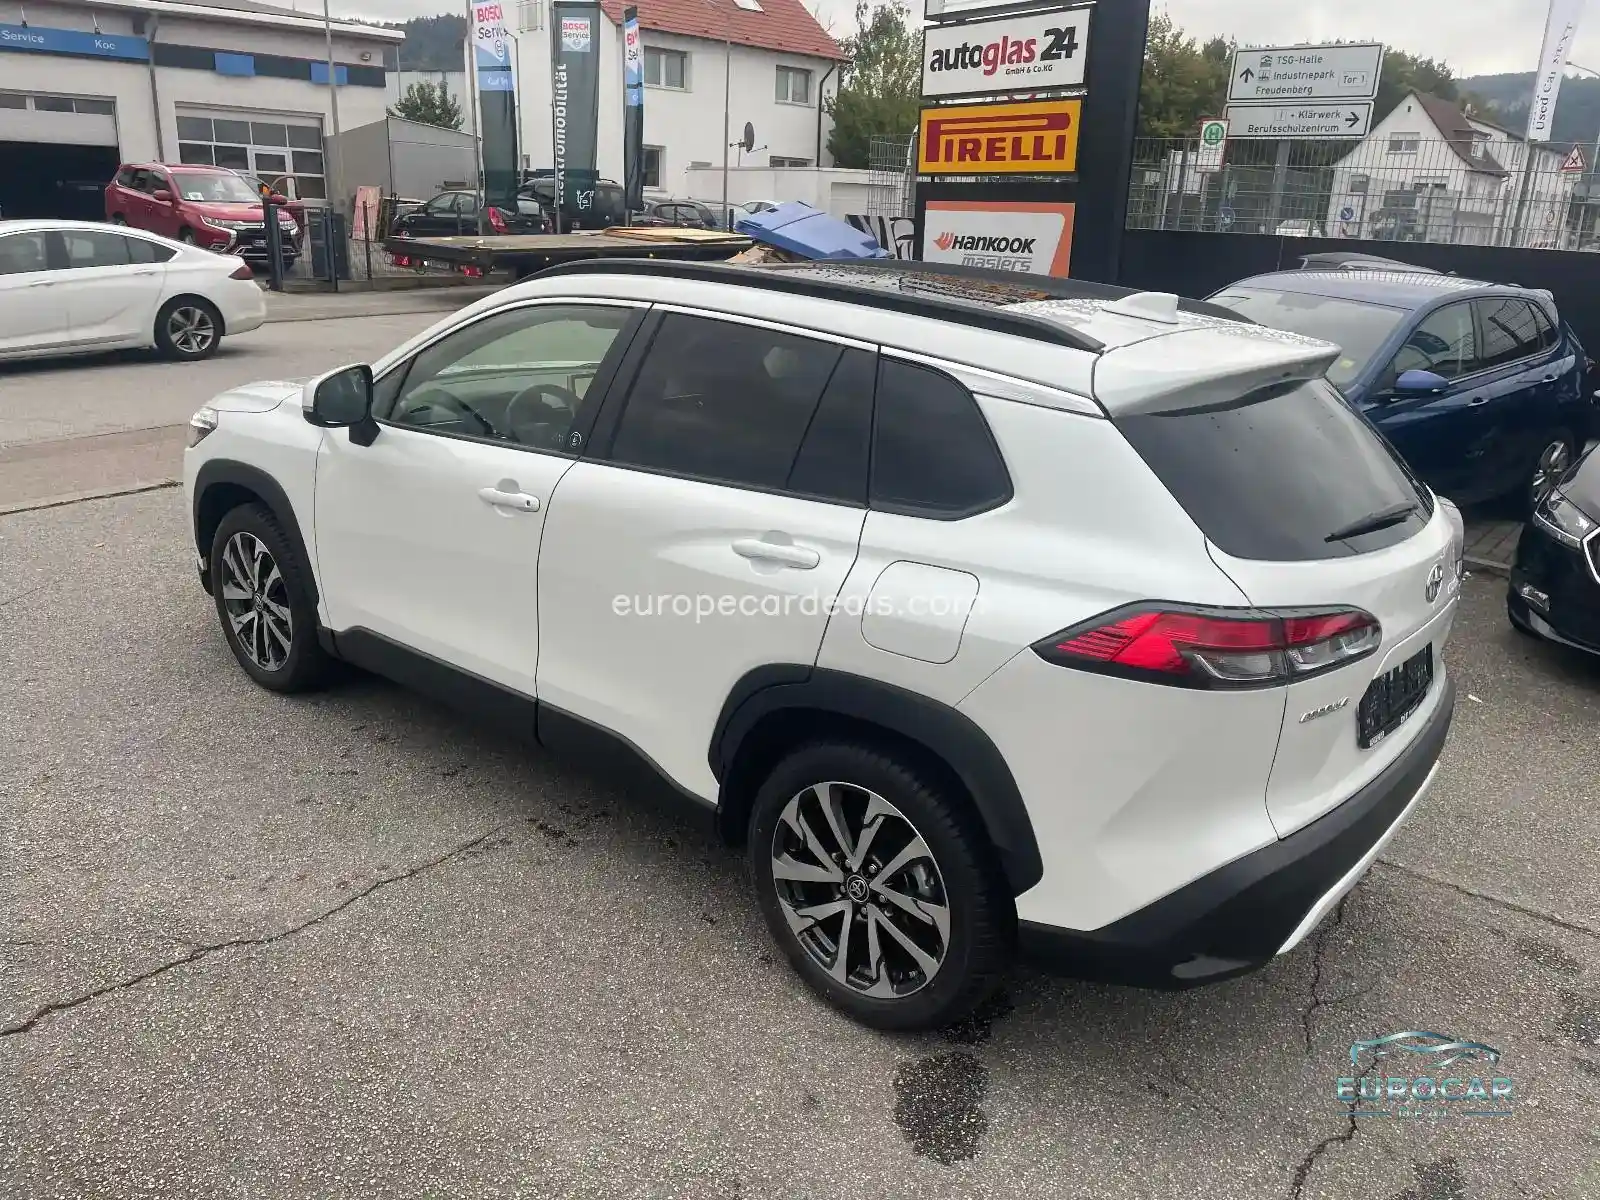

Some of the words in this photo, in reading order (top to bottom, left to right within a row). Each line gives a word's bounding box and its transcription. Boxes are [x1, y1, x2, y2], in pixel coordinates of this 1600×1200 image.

[563, 22, 589, 30] BOSCH
[562, 31, 590, 39] Service
[1, 30, 44, 44] Service
[94, 39, 116, 50] Koc
[930, 36, 1036, 76] autoglas
[1040, 26, 1078, 61] 24
[1276, 55, 1323, 64] TSG-Halle
[1005, 66, 1025, 75] GmbH
[1273, 70, 1335, 80] Industriepark
[1343, 76, 1357, 84] Tor
[1255, 86, 1313, 95] Freudenberg
[1298, 110, 1342, 119] Klärwerk
[1247, 123, 1339, 133] Berufsschulzentrum
[925, 113, 1071, 162] PIRELLI
[961, 254, 1032, 273] masters
